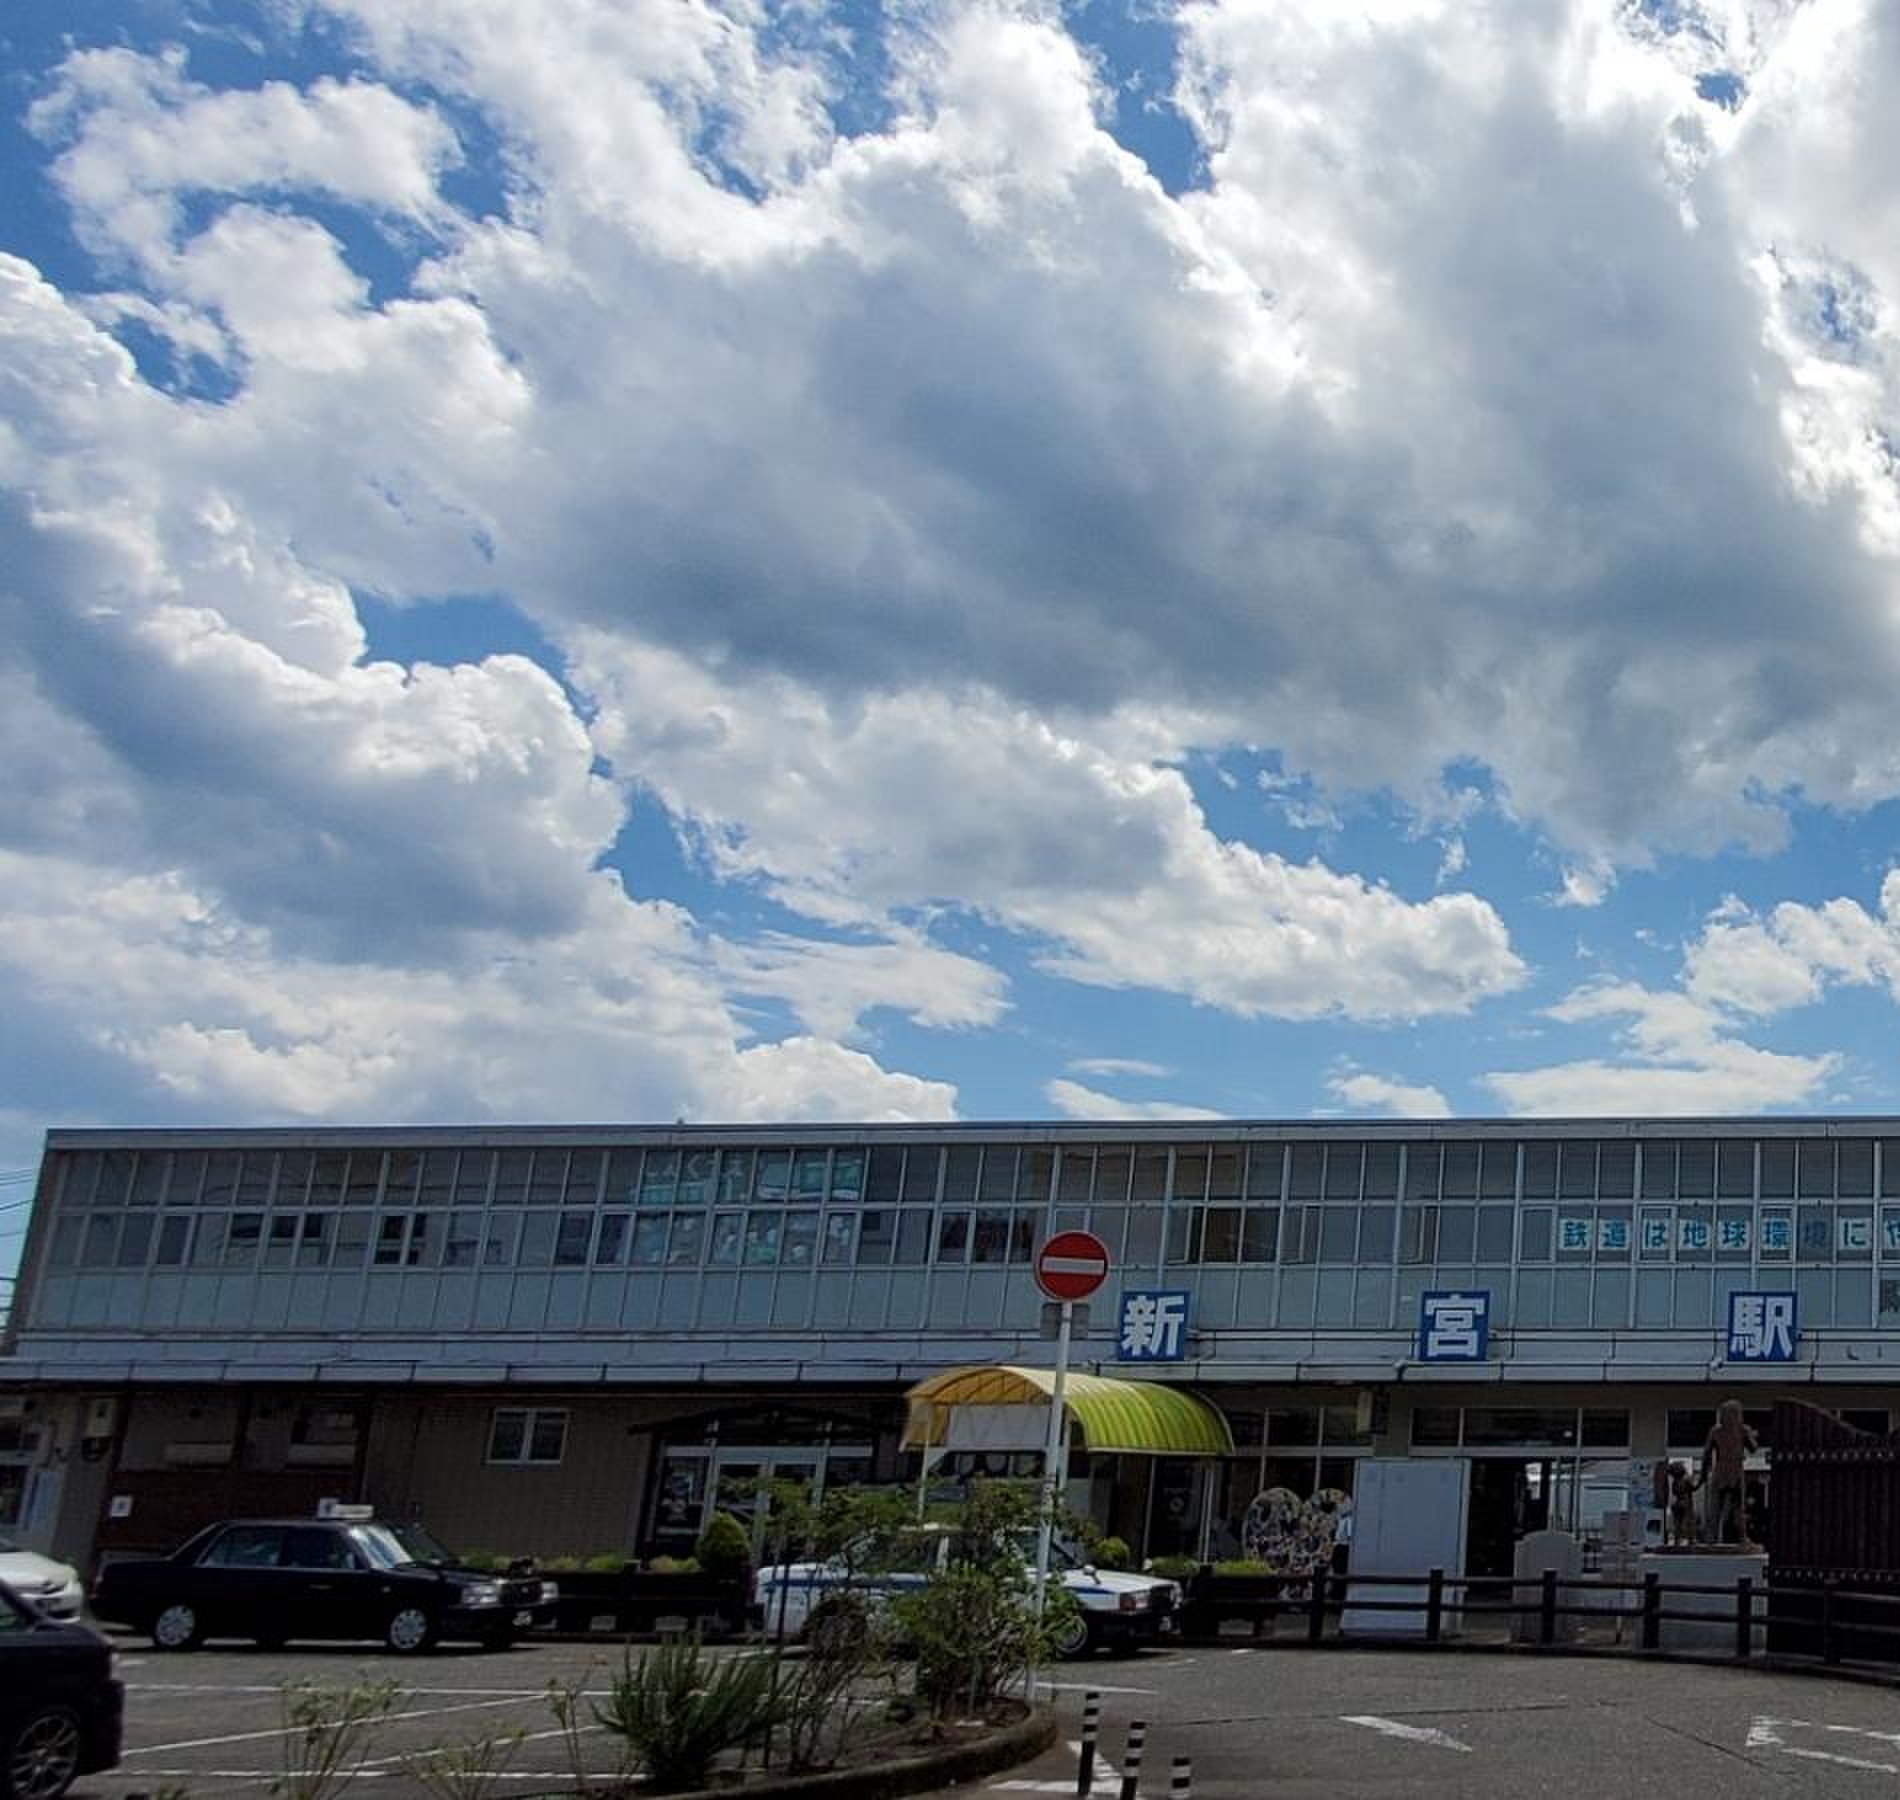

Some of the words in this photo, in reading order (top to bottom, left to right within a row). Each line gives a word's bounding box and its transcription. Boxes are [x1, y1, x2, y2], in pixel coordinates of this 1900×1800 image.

[1121, 1295, 1185, 1357] 新
[1425, 1294, 1485, 1357] 宮
[1729, 1295, 1793, 1358] 駅
